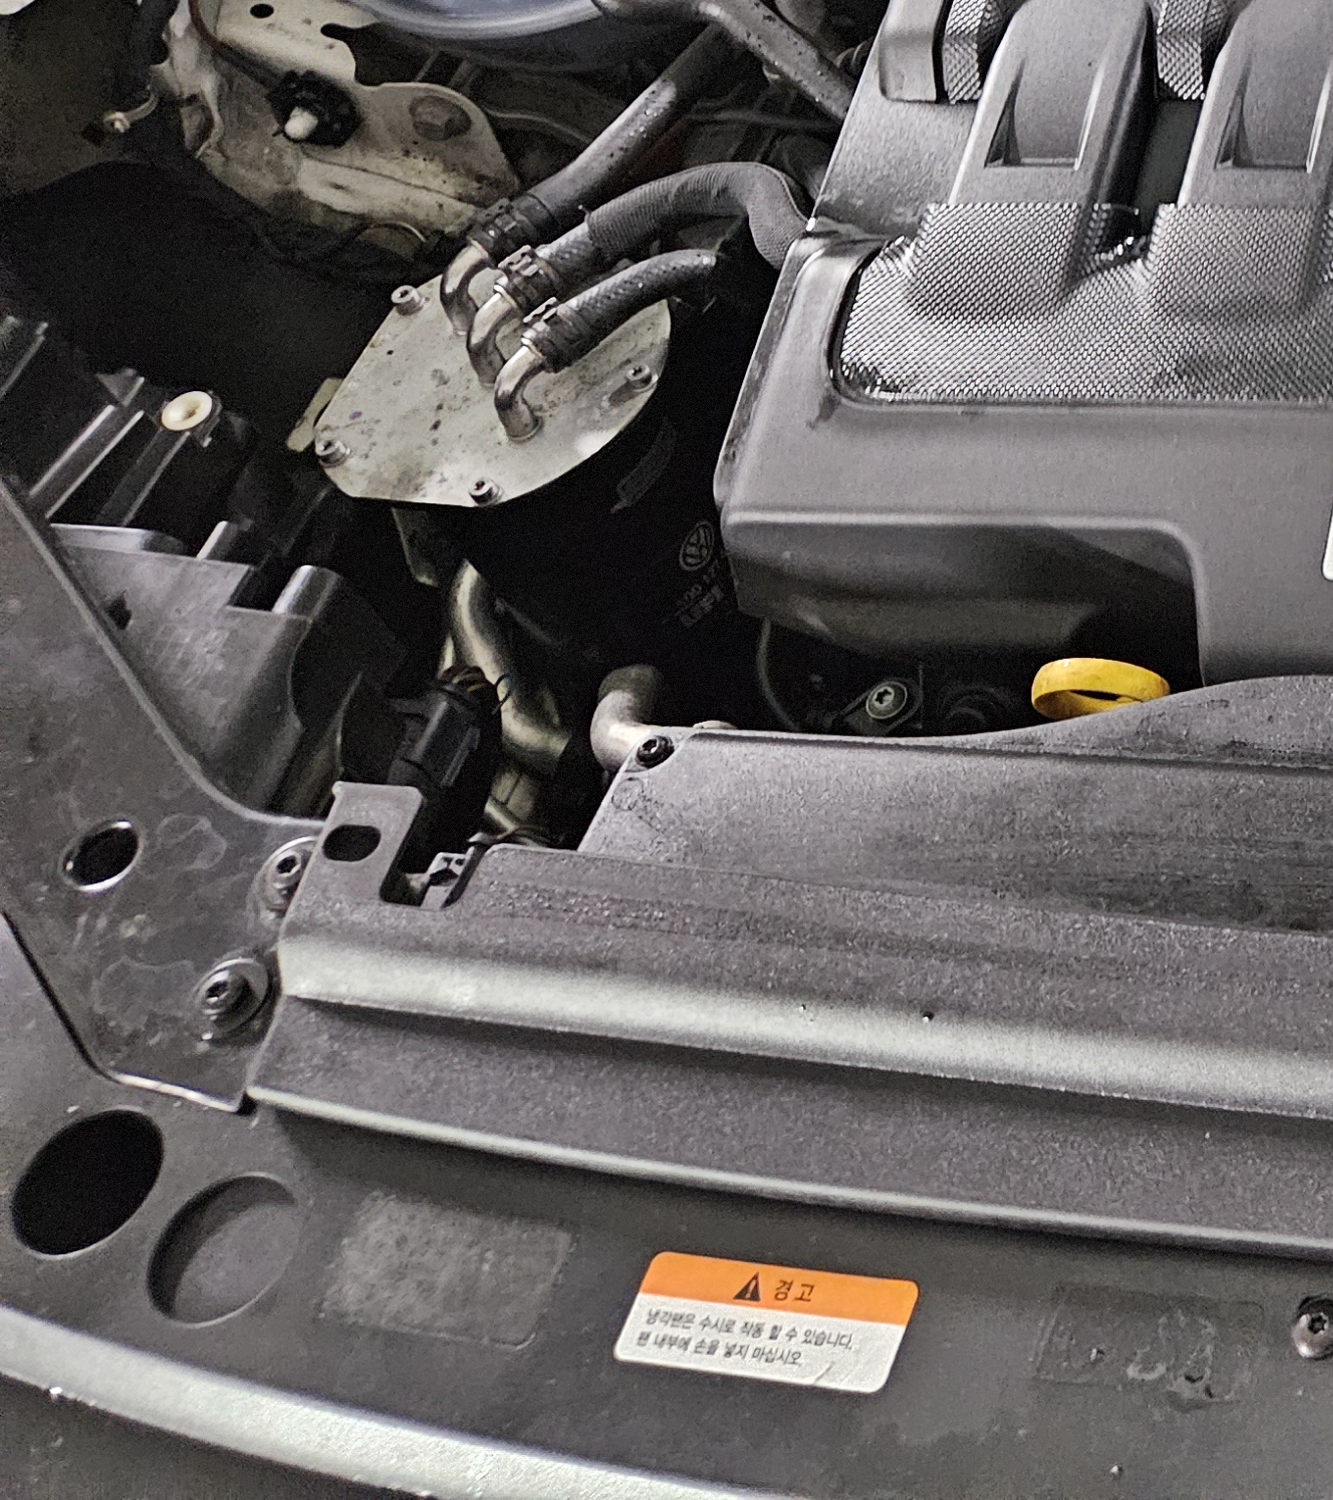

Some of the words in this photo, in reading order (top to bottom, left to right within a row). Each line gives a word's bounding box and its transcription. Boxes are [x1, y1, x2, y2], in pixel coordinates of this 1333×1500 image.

[773, 1279, 815, 1303] 경고
[698, 1314, 736, 1334] 수시로
[738, 1321, 766, 1340] 작동
[785, 1327, 800, 1342] 수
[801, 1329, 853, 1351] 있습니다.
[752, 1348, 804, 1367] 마십시오.
